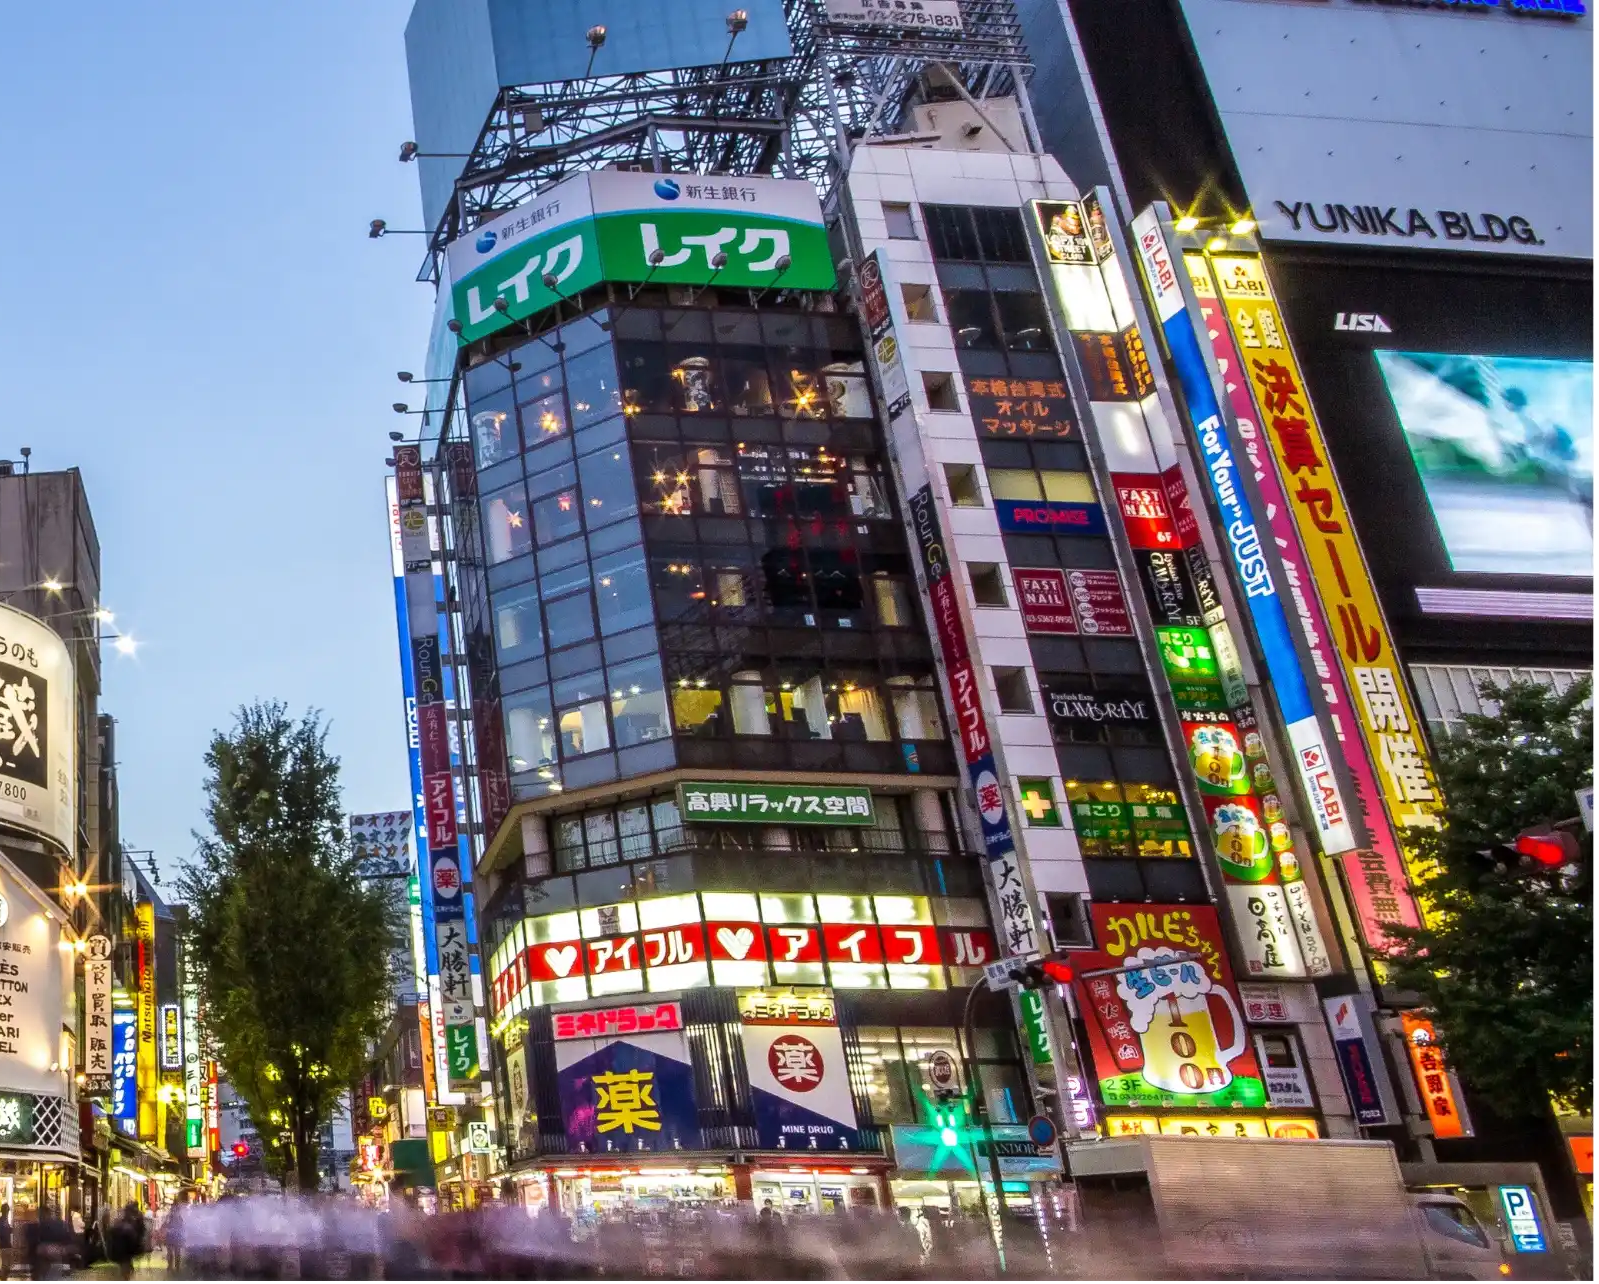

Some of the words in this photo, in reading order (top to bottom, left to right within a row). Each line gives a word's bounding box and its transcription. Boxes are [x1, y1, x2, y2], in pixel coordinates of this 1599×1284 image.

[685, 184, 756, 202] 新生銀行
[502, 200, 561, 241] 新生銀行
[1275, 200, 1436, 239] YUNIKA
[1438, 210, 1546, 247] BLDG.
[641, 222, 791, 272] レイク
[467, 233, 583, 326] レイク
[1152, 247, 1174, 291] LABI
[1224, 280, 1266, 291] LABI
[1334, 312, 1393, 333] LISA
[995, 400, 1050, 417] オイル
[982, 419, 1071, 437] マッサージ
[1197, 413, 1220, 457] For
[1121, 488, 1161, 502] FAST
[1125, 503, 1169, 518] NAIL
[1013, 508, 1090, 525] PROMISE
[1157, 531, 1172, 543] 6F
[1228, 519, 1276, 599] JUST
[1023, 580, 1058, 590] FAST
[1025, 593, 1063, 604] NAIL
[1186, 615, 1203, 626] 5F
[954, 669, 985, 752] アイフル
[431, 778, 453, 843] アイフル
[686, 791, 869, 816] 高興リラックス空間
[978, 783, 1002, 813] 薬
[1314, 771, 1343, 826] LABI
[435, 868, 459, 889] 薬
[998, 860, 1034, 951] 大勝軒
[440, 926, 470, 997] 大勝軒
[589, 930, 694, 976] アイフル
[773, 927, 986, 966] アイフル
[1106, 911, 1223, 980] カルビちゃん
[493, 956, 528, 1013] アイフル
[556, 1003, 680, 1038] ミネドラッグ
[754, 1003, 836, 1021] ミネドラッグ
[1090, 979, 1139, 1061] 炭火焼肉
[1246, 1001, 1287, 1021] 修理
[453, 1029, 470, 1072] レイク
[773, 1042, 820, 1083] 薬
[591, 1069, 664, 1135] 薬
[1269, 1082, 1303, 1093] カスタム
[782, 1125, 805, 1134] MINE
[1359, 1109, 1382, 1119] プロミス
[1506, 1192, 1524, 1216] P
